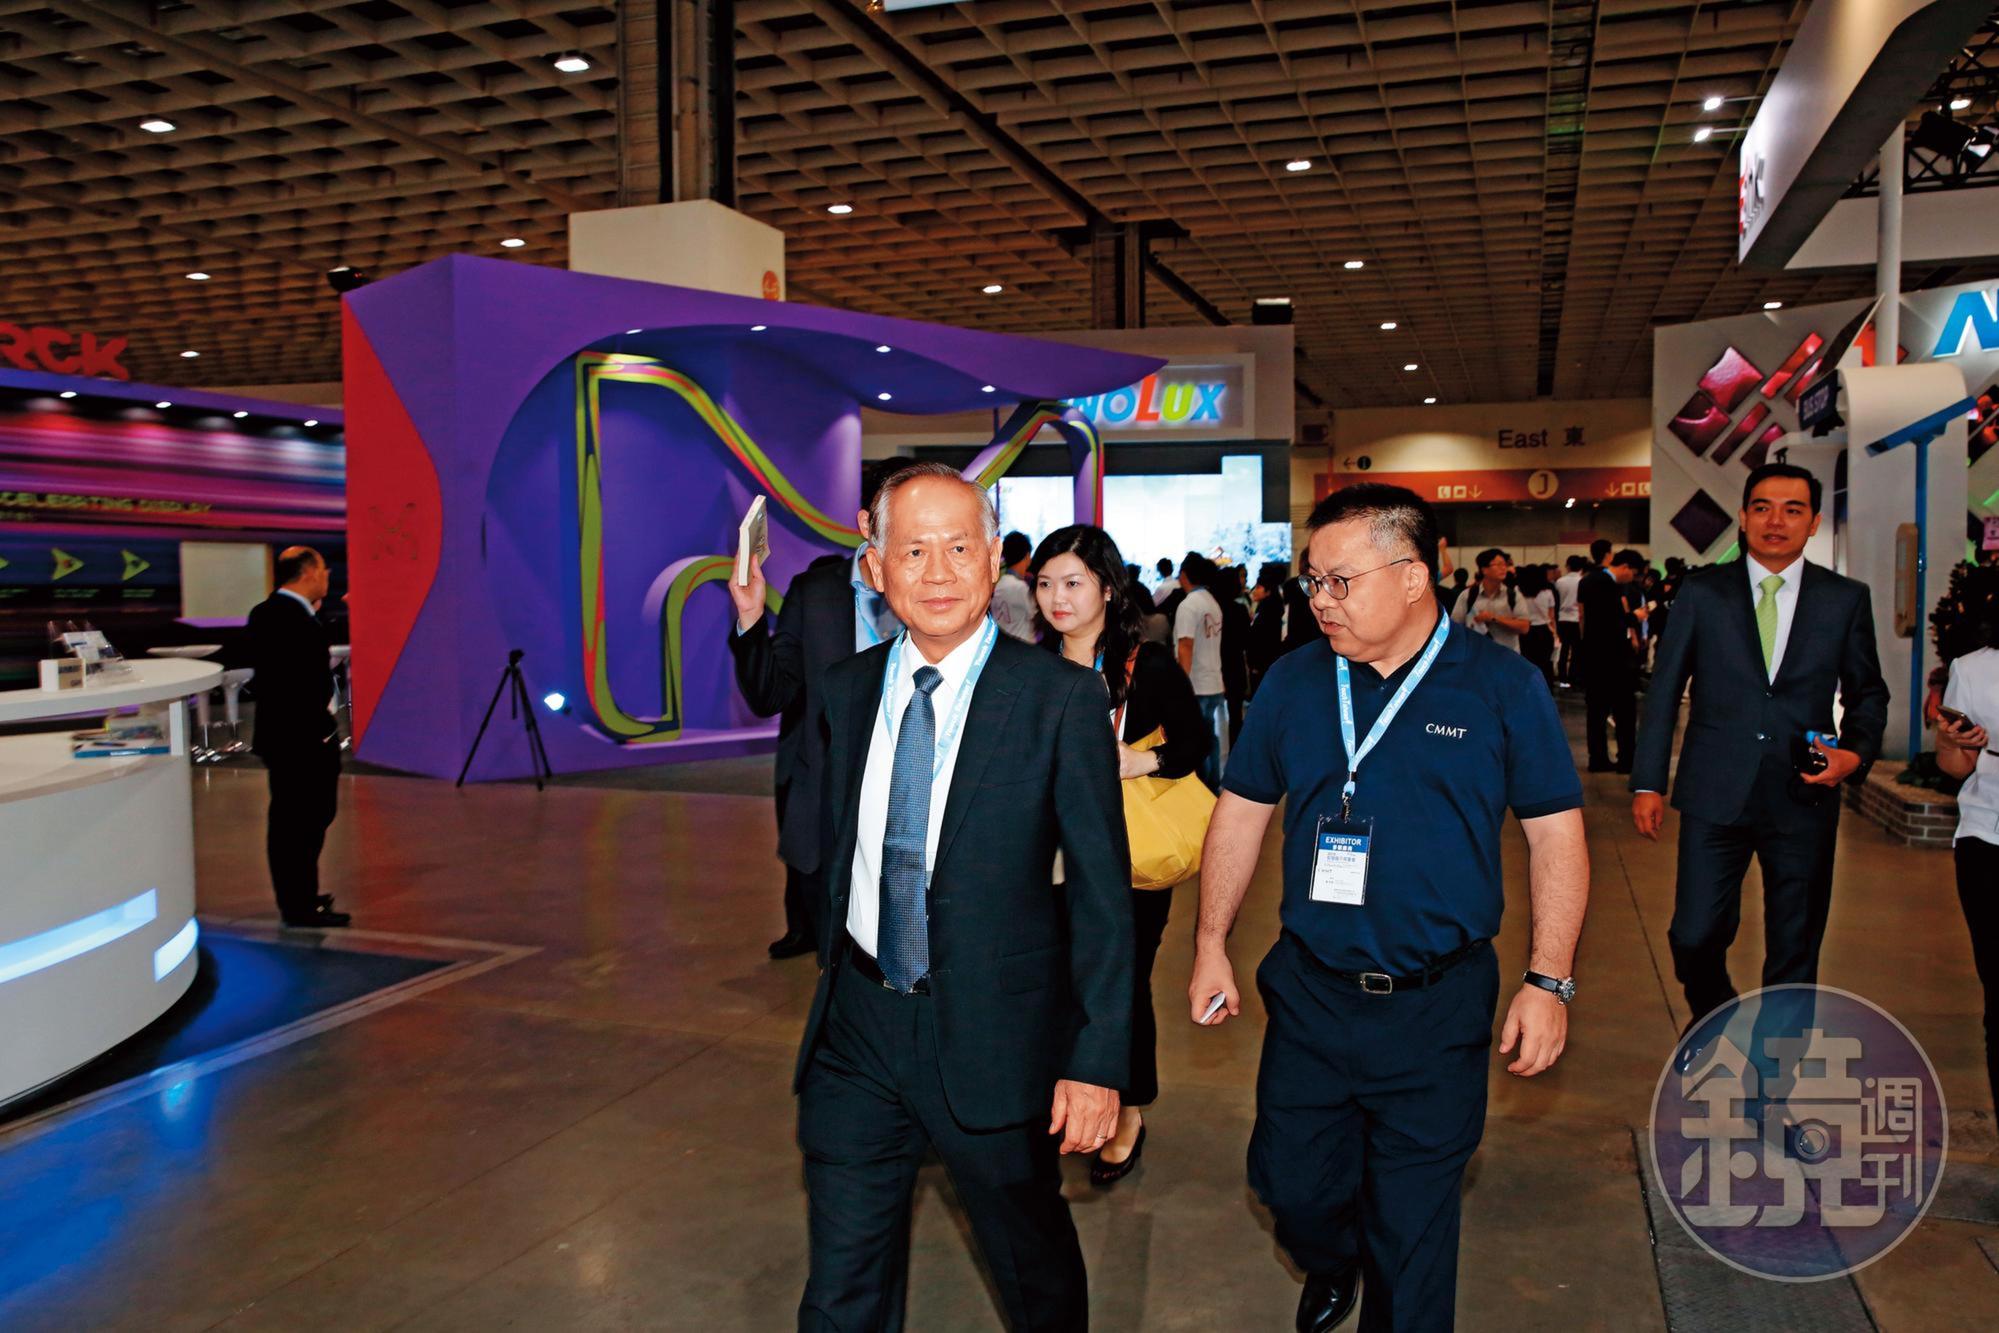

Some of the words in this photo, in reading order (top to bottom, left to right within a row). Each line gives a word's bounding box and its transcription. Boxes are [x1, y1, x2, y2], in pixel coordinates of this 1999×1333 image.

[0, 321, 129, 381] RCK
[1498, 428, 1549, 449] East
[1563, 425, 1585, 447] 東
[1537, 473, 1549, 496] J
[1425, 722, 1468, 739] CMMT
[1325, 836, 1362, 847] EXHIBITOR
